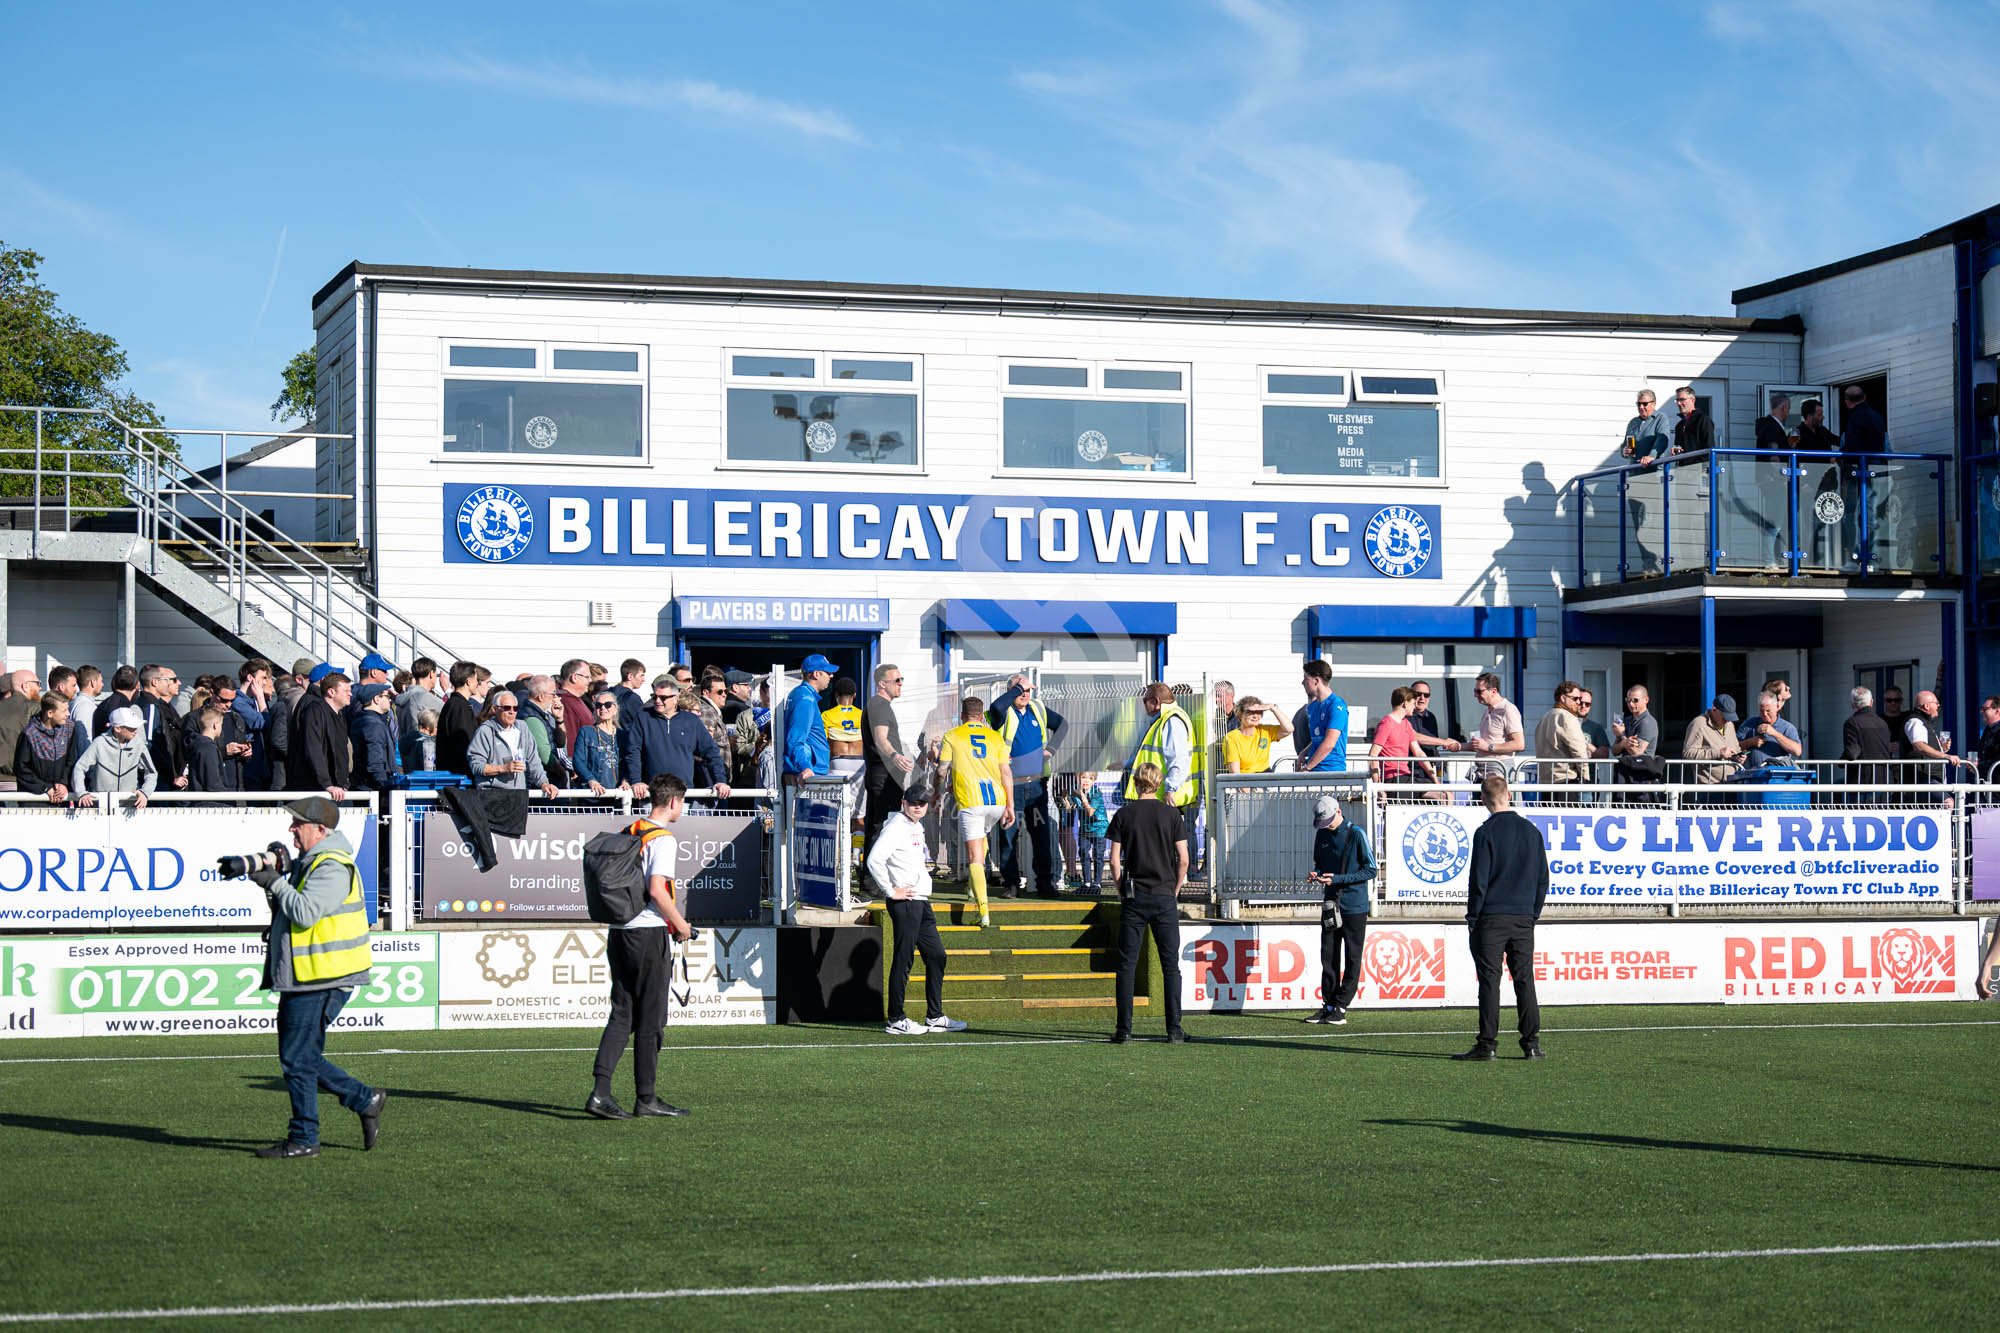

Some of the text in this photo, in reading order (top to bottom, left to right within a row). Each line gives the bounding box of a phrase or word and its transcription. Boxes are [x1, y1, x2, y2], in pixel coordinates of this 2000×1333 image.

[1328, 414, 1373, 424] THE SYMES
[1337, 425, 1364, 435] PRESS
[1337, 447, 1364, 456] MEDIA
[1339, 458, 1363, 468] SUITE
[459, 487, 532, 524] BILLERICAY
[548, 496, 969, 561] BILLERICAY
[993, 506, 1209, 564] TOWN
[1367, 508, 1431, 542] BILLERICAY
[464, 532, 502, 560] TOWN
[1371, 549, 1405, 575] TOWN
[689, 601, 880, 622] PLAYERS & OFFICIALS
[970, 734, 987, 760] 5
[1404, 812, 1469, 848] BILLERICAY
[1526, 814, 1939, 852] TFC LIVE RADIO
[509, 832, 586, 861] wisd
[678, 835, 735, 869] sign
[1407, 855, 1444, 882] TOWN
[1550, 860, 1940, 878] Got Every Game Covered @btfcliveradio
[510, 875, 734, 893] branding ecialists
[1398, 889, 1420, 898] BTFC
[1580, 883, 1605, 895] for
[1609, 884, 1643, 895] free
[1647, 884, 1674, 896] via
[1678, 884, 1705, 896] the
[1709, 883, 1790, 898] Billericay
[1794, 883, 1839, 895] Town
[1842, 882, 1863, 894] FC
[1867, 882, 1904, 894] Club
[1908, 882, 1940, 897] App
[509, 903, 535, 911] Follow
[69, 946, 109, 957] Essex
[115, 943, 188, 957] Approved
[193, 943, 236, 954] Home
[371, 940, 421, 952] cialists
[1561, 951, 1604, 965] THE
[1611, 951, 1671, 964] ROAR
[1195, 939, 1306, 984] RED
[1724, 937, 1827, 980] RED
[1554, 967, 1609, 980] HIGH
[1615, 966, 1698, 980] STREET
[69, 968, 219, 1009] 01702
[1725, 981, 1882, 996] BILLERICAY
[496, 996, 561, 1007] DOMESTIC
[0, 1008, 35, 1030] td
[451, 1011, 609, 1022] WWW.AXELEYELECTRICAL.CO.
[667, 1010, 697, 1019] HONE:
[700, 1010, 728, 1018] 01277
[730, 1010, 746, 1018] 631
